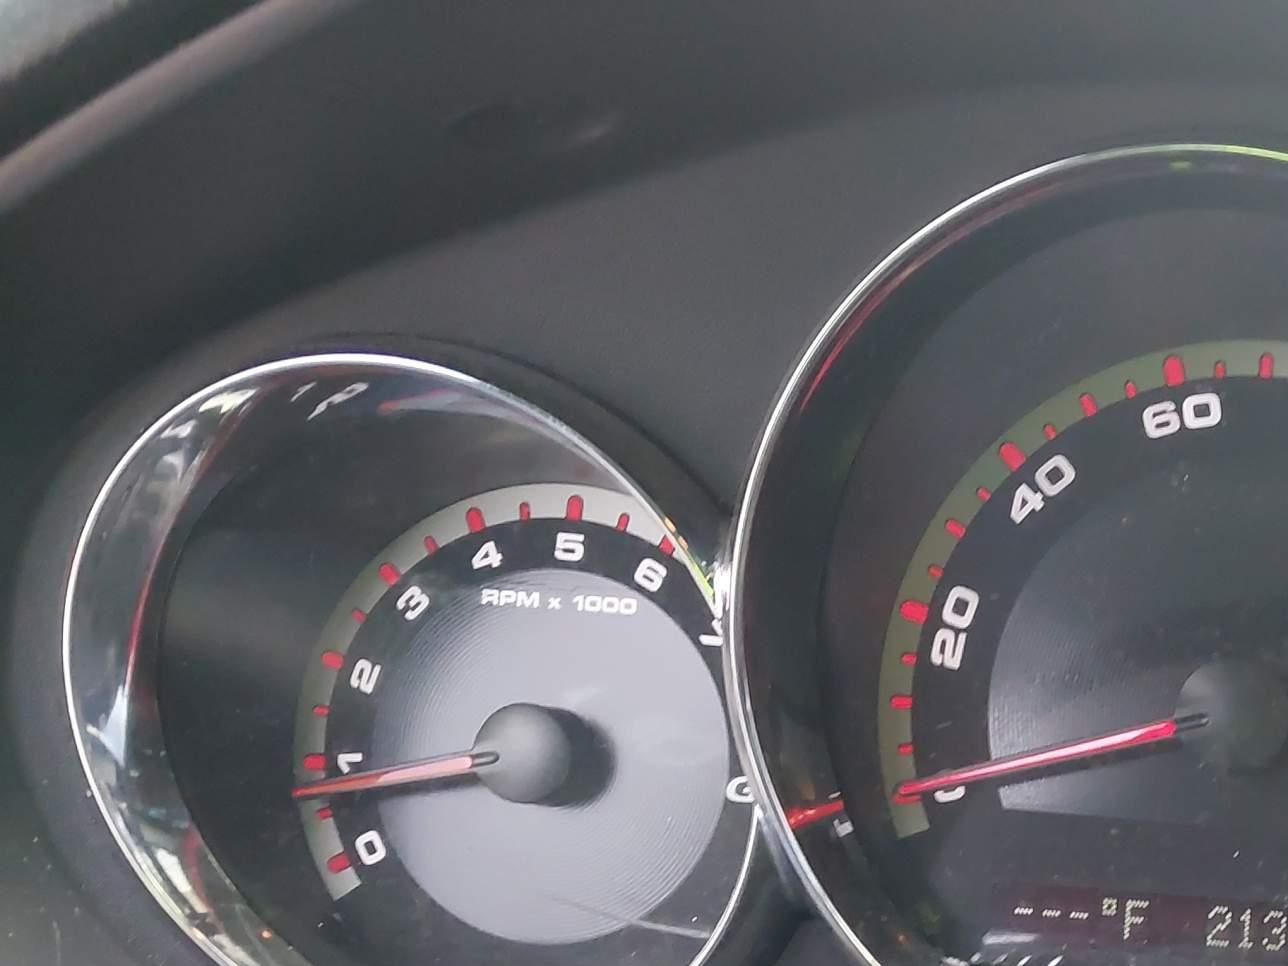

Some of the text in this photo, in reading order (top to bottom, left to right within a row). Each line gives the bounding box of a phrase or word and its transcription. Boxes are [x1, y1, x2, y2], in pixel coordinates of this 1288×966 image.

[1142, 393, 1222, 438] 60
[1009, 454, 1076, 524] 40
[471, 539, 504, 570] 4
[553, 532, 585, 562] 5
[633, 557, 668, 594] 6
[396, 584, 430, 622] 3
[480, 587, 540, 609] RPM
[572, 594, 638, 615] 1000
[930, 584, 980, 670] 20
[350, 658, 382, 695] 2
[336, 752, 363, 774] 1
[355, 830, 387, 866] 0
